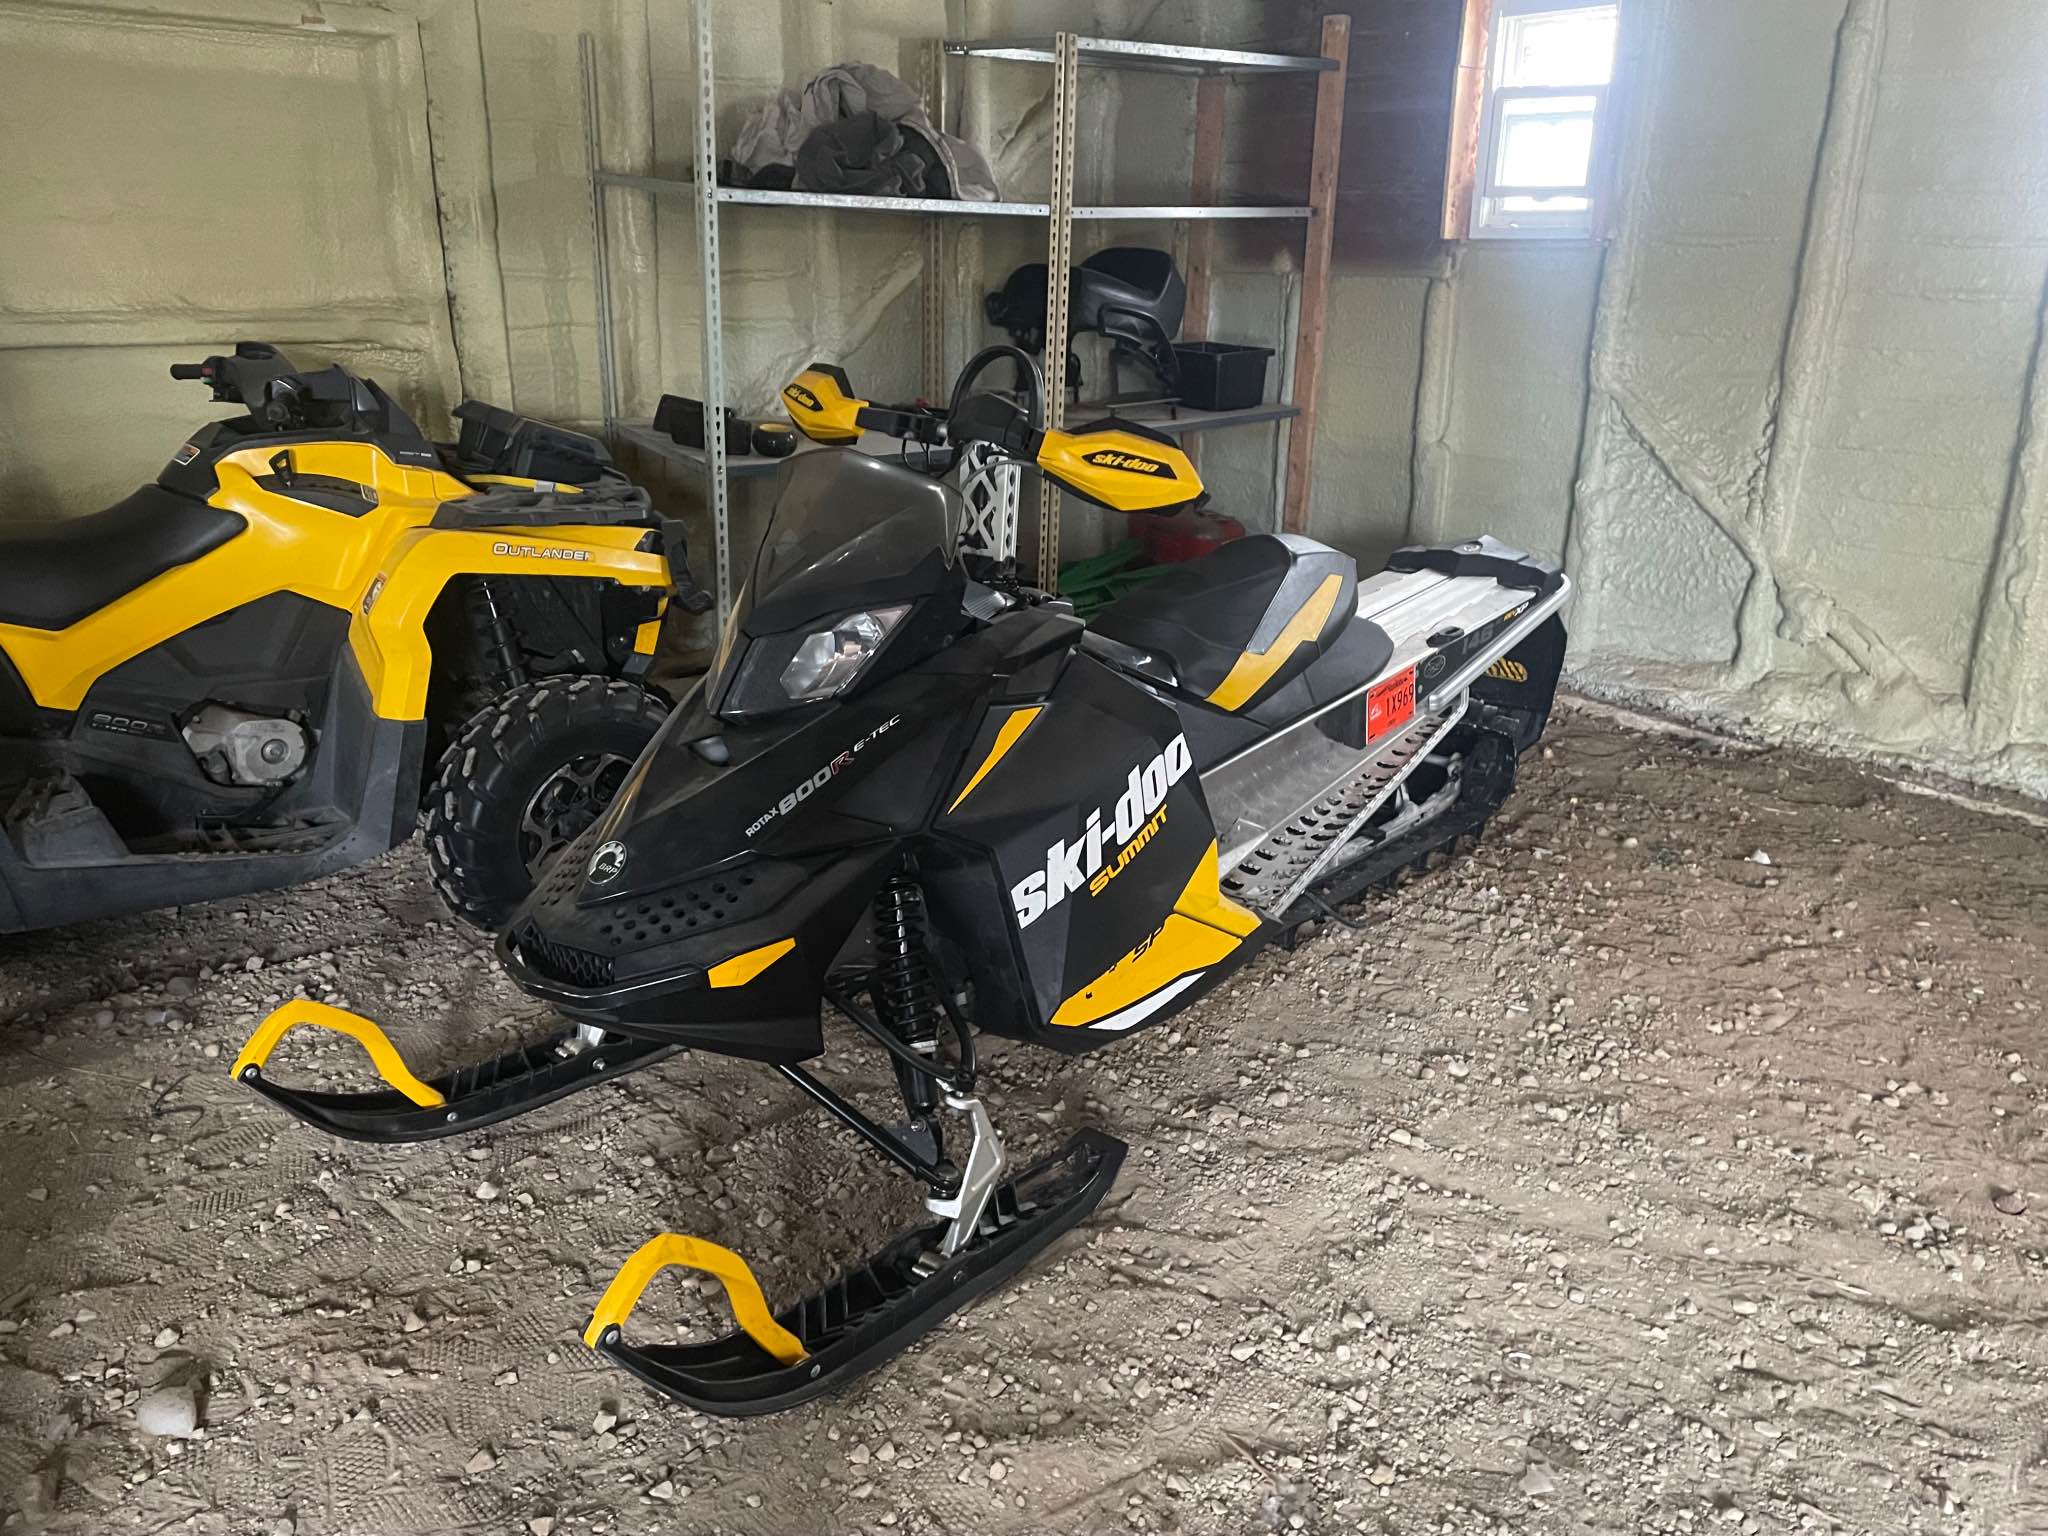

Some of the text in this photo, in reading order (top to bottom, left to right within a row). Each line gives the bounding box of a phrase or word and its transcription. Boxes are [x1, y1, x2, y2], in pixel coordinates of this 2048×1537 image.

[1092, 453, 1160, 473] ski-doo
[745, 806, 779, 838] ROTAX
[853, 714, 901, 753] E-TEC
[1010, 732, 1193, 930] ski-doo
[598, 862, 619, 874] BRP
